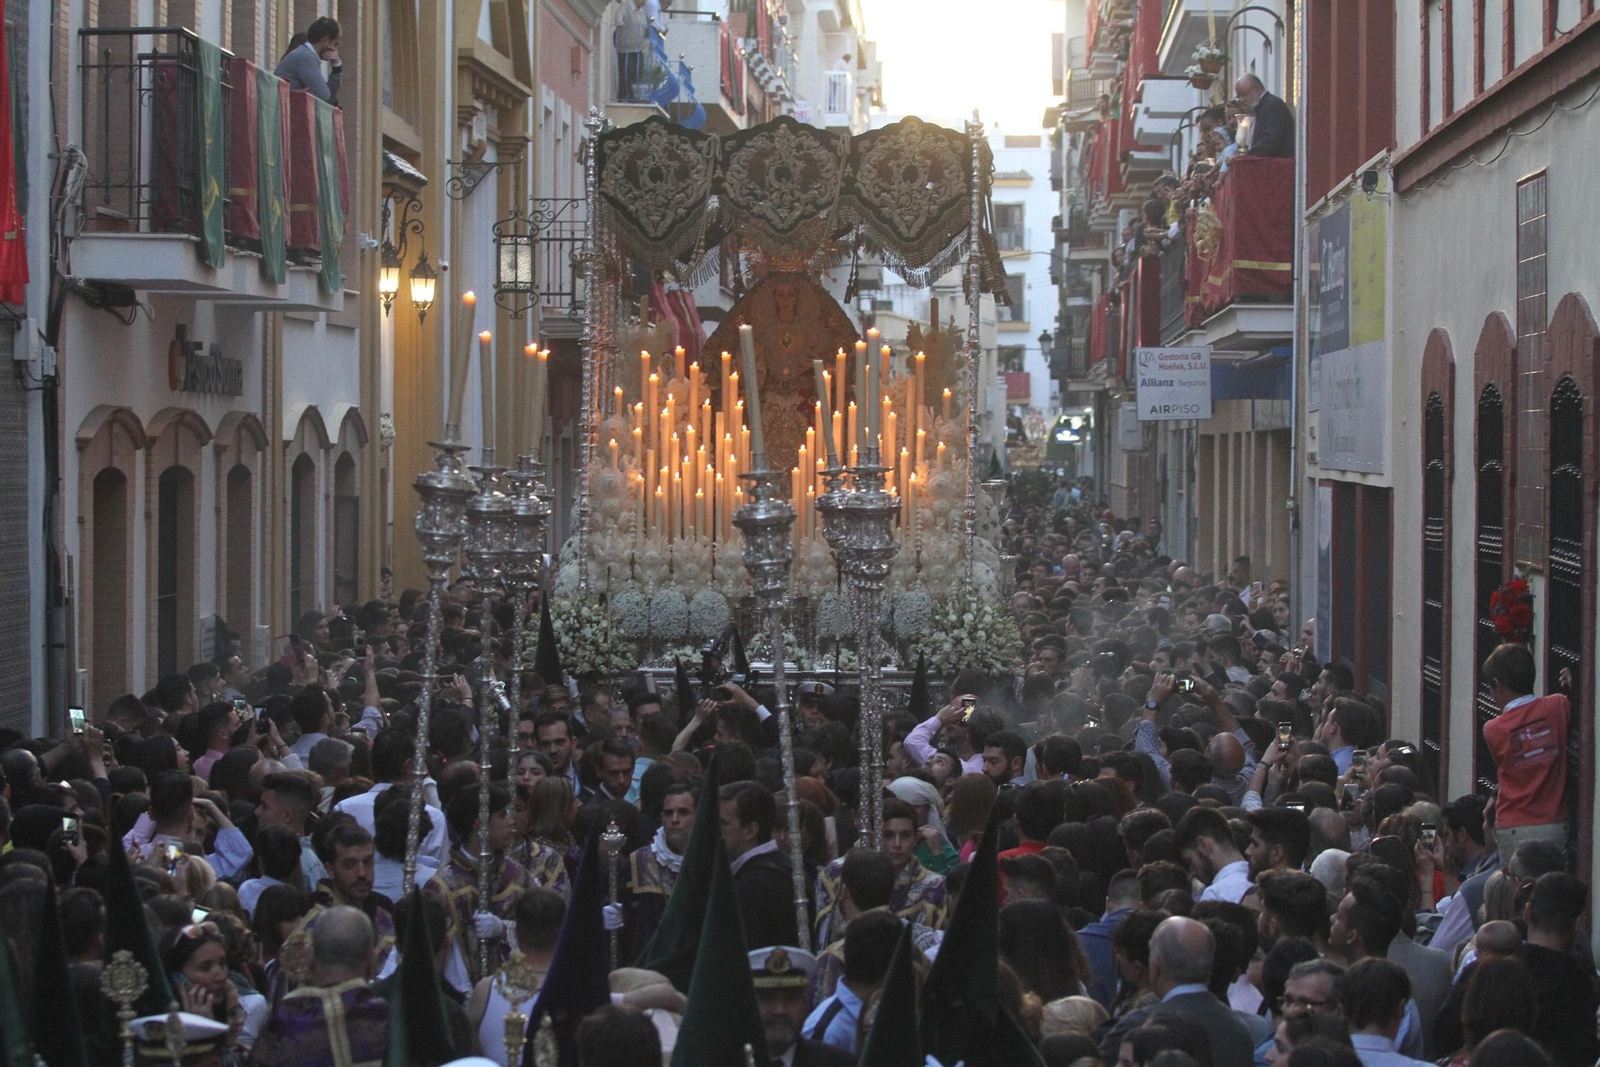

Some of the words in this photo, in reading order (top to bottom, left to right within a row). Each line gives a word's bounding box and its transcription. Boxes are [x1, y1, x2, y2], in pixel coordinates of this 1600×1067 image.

[1158, 362, 1186, 371] Huelva,
[1187, 362, 1208, 370] S.L.U.
[1140, 378, 1175, 387] Allianz
[1178, 380, 1207, 388] Seguros
[1149, 404, 1200, 414] AIRPISO
